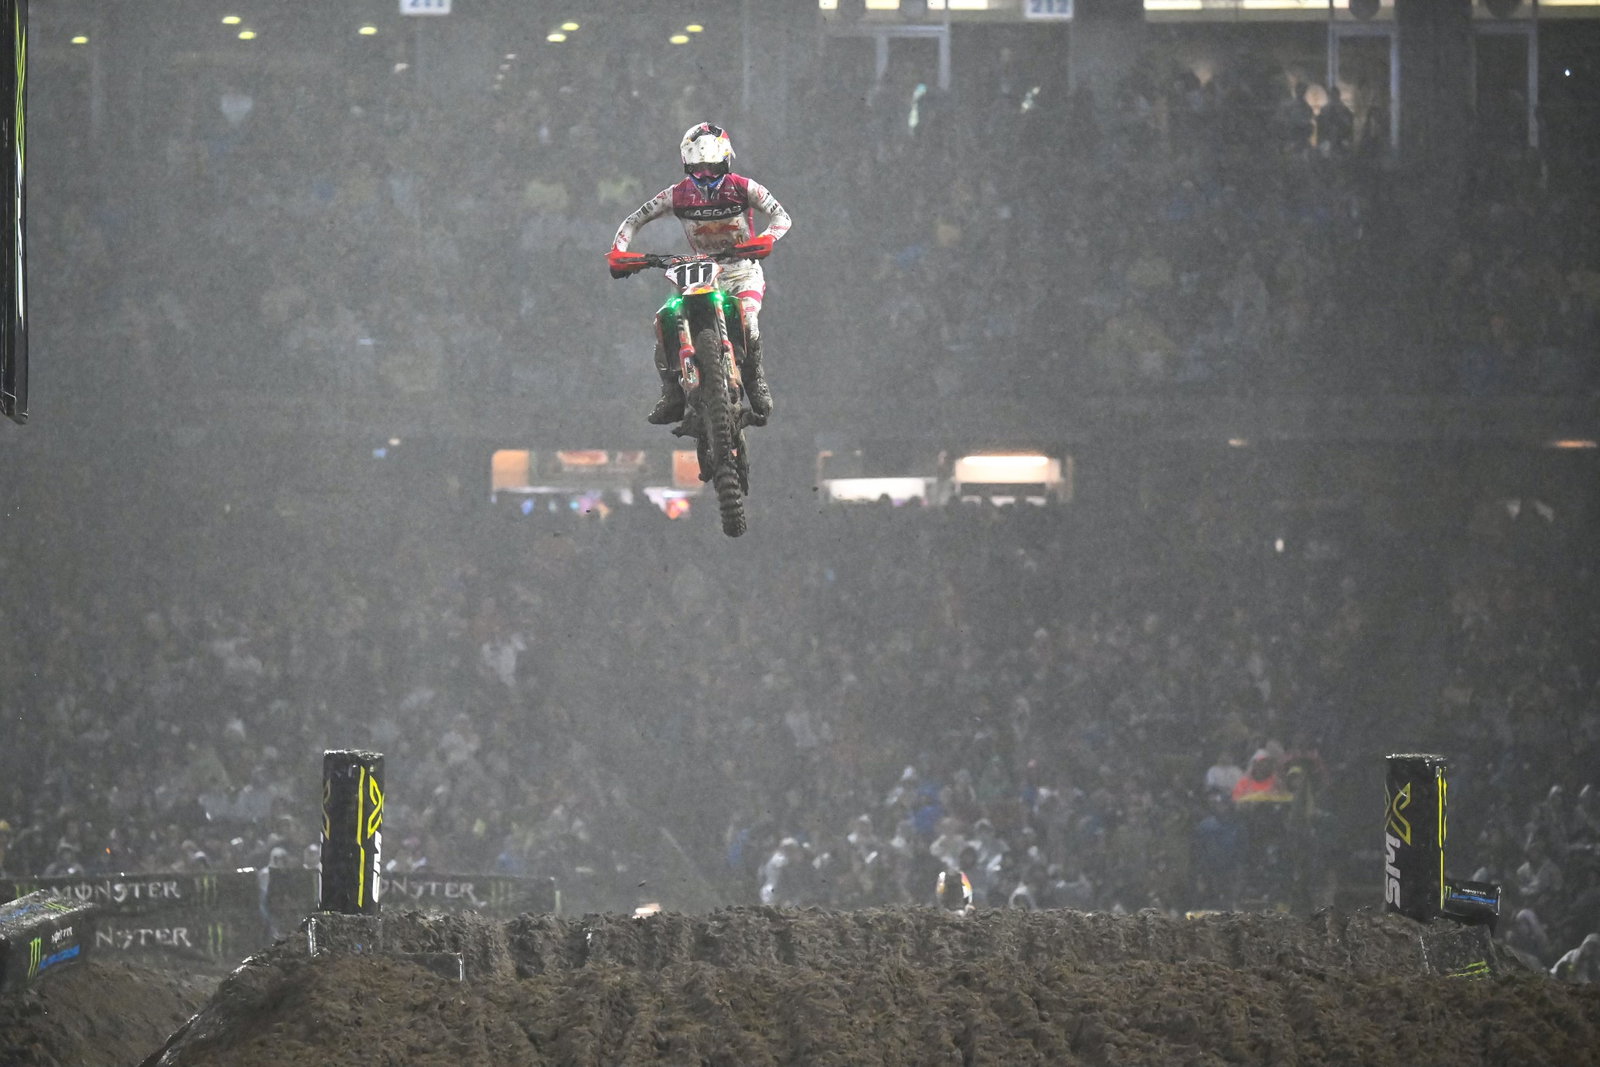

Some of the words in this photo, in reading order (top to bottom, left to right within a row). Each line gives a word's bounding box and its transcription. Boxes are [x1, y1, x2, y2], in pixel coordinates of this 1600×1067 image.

[694, 205, 741, 217] ASGAS
[674, 263, 713, 287] 111
[51, 879, 181, 902] MONSTER
[95, 926, 192, 949] NSTER
